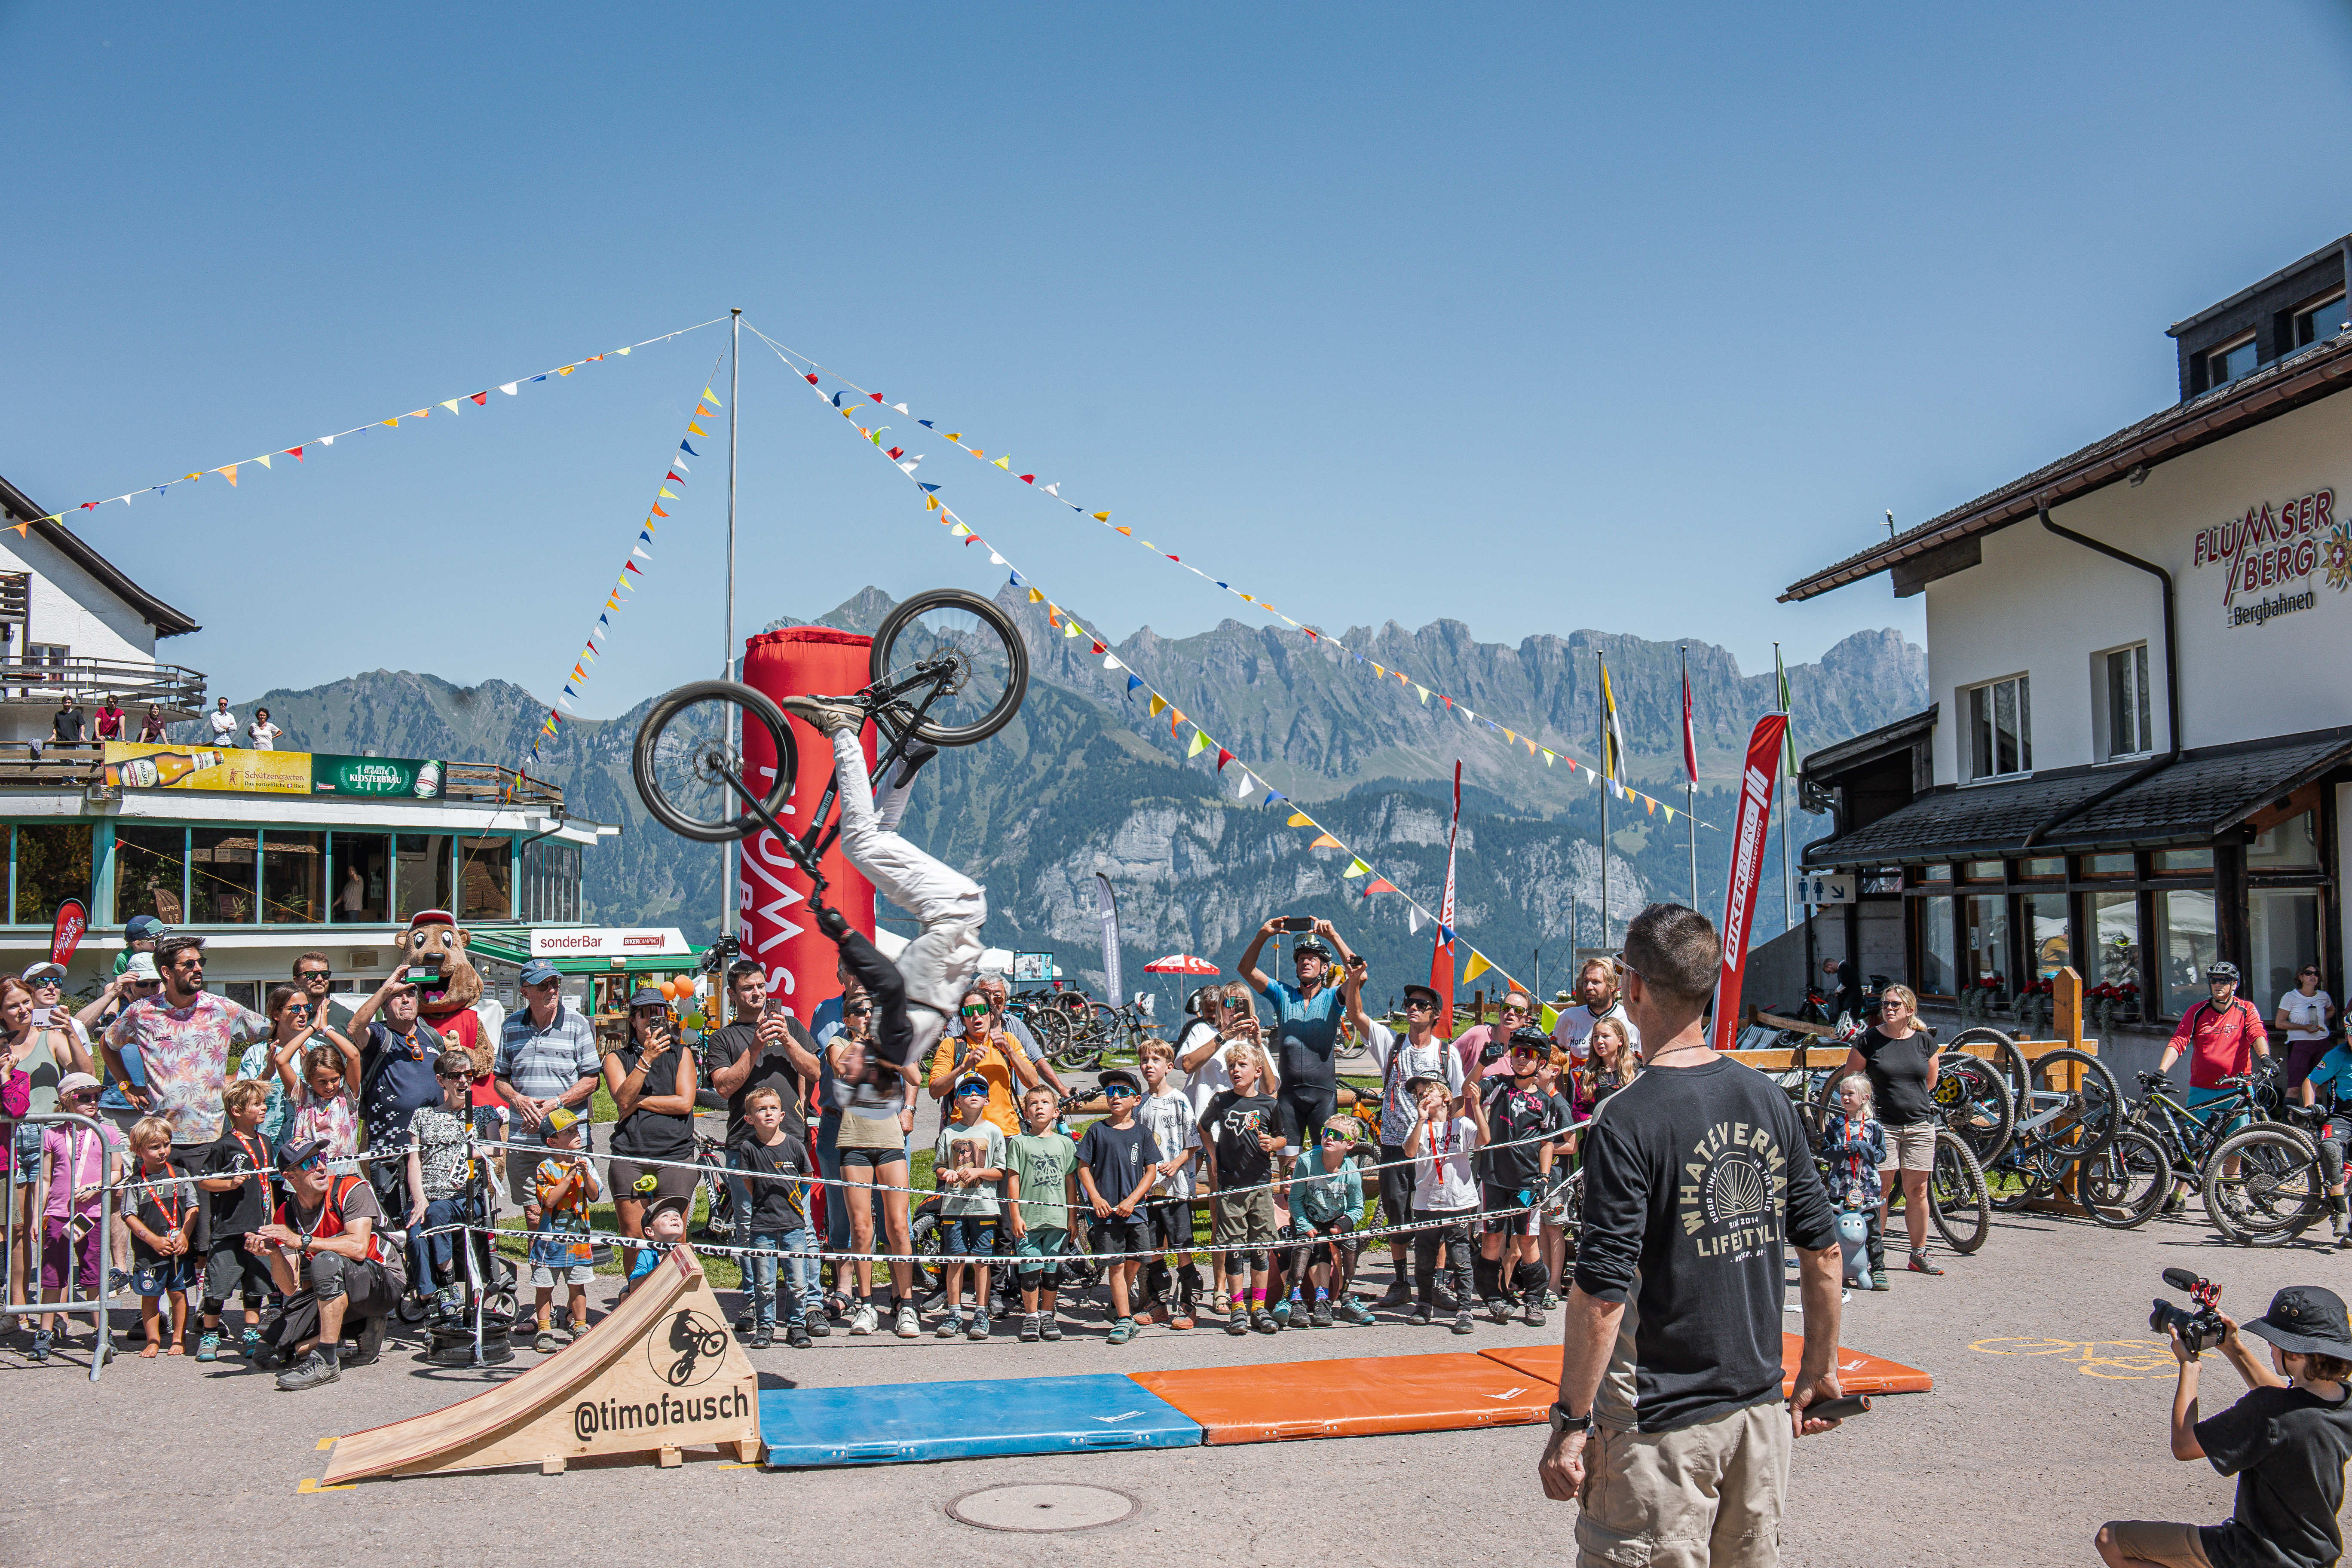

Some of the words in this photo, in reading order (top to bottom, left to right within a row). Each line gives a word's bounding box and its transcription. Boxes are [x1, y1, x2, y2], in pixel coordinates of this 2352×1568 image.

[2193, 490, 2332, 606] FLUMSER
[2243, 538, 2315, 592] BERG
[2234, 591, 2314, 626] Bergbahnen
[139, 762, 149, 785] EDELSPEZ
[245, 771, 305, 783] Schützengarten
[349, 774, 401, 784] KLOSTERBRÄU
[355, 764, 398, 791] 1779
[1748, 818, 1763, 888] Flumserberg
[1728, 808, 1755, 959] BIKERBERG
[64, 926, 77, 948] BERG
[540, 935, 602, 948] sonderBar
[1569, 1038, 1586, 1046] Moto
[1753, 1159, 1762, 1169] IN
[1761, 1169, 1772, 1186] THE
[1706, 1197, 1719, 1224] GOOD
[1764, 1189, 1773, 1211] WILD
[1740, 1216, 1758, 1225] 2014
[144, 1267, 156, 1278] 30
[575, 1385, 748, 1442] @timofausch
